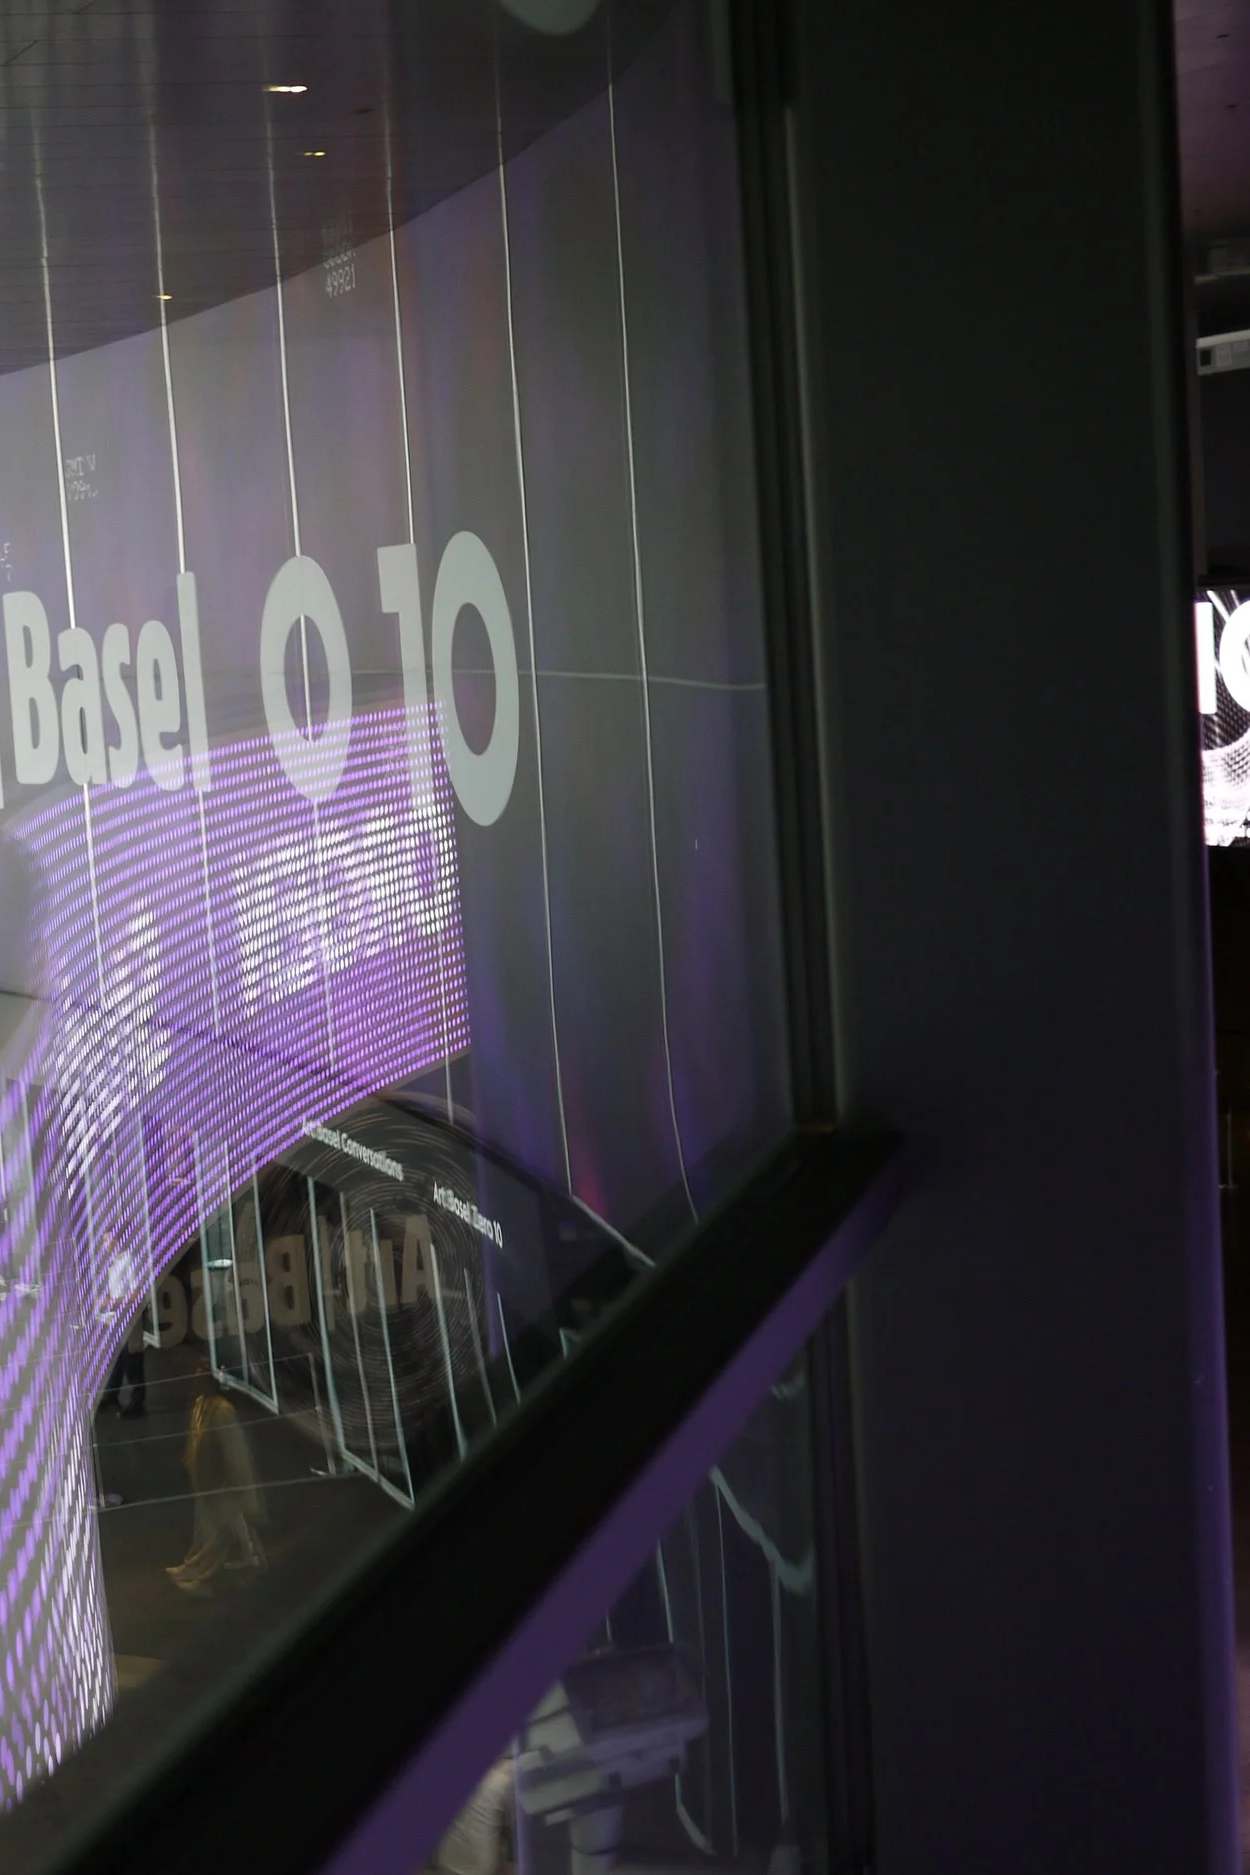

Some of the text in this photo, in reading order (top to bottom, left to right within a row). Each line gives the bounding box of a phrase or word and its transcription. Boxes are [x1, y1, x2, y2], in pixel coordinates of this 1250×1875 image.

[341, 1132, 404, 1182] Conversations
[433, 1180, 447, 1208] Art
[446, 1189, 471, 1226] Basel
[493, 1220, 504, 1249] 10
